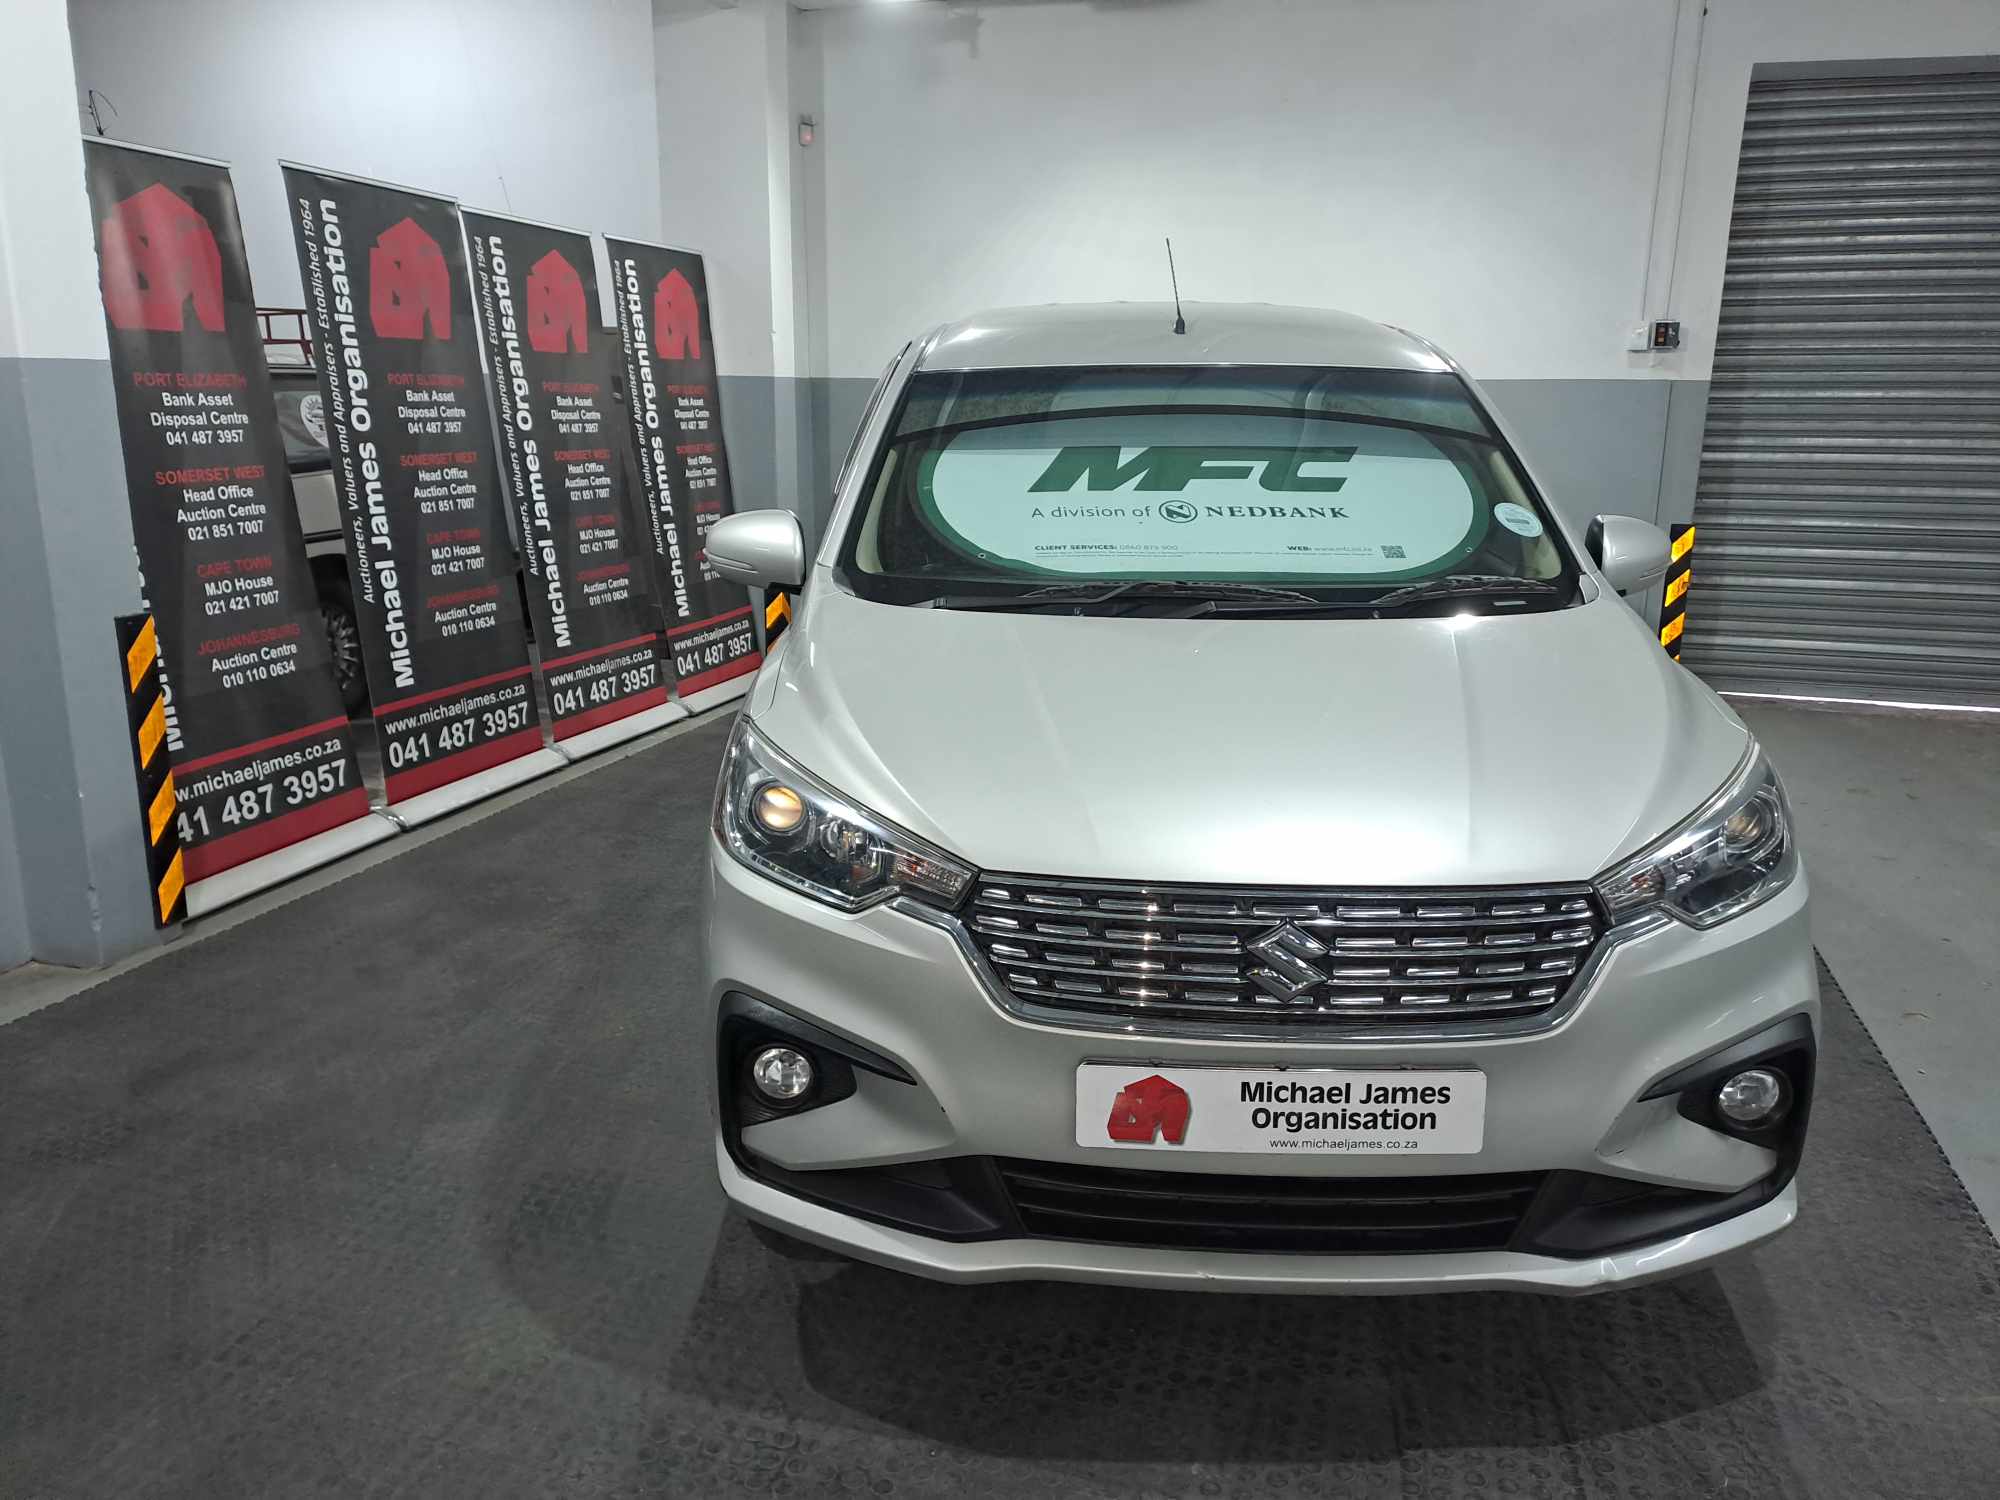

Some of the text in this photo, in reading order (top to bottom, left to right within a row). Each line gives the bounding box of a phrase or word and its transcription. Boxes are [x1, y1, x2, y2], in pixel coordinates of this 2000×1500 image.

[133, 371, 172, 387] PORT
[162, 391, 234, 407] Bank Asset
[299, 198, 375, 603] Auctioneers, Valuers and Appraisers Established 1964
[406, 390, 455, 402] Bank Asset
[473, 235, 539, 576] Auctioneers, Valuers and Appraisers Established 1964
[150, 410, 249, 428] Disposal Centre
[397, 405, 466, 420] Disposal Centre
[166, 429, 244, 446] 041 487 3957
[407, 422, 424, 434] 041
[425, 421, 441, 433] 487
[624, 258, 690, 617] Michael James Organisation
[320, 199, 415, 688] Michael James Organisation
[488, 236, 572, 648] Michael James Organisation
[155, 467, 230, 485] SOMERSET
[418, 467, 468, 481] Head Office
[1027, 445, 1358, 493] MFC
[183, 485, 254, 503] Head Office
[414, 483, 478, 498] Auction Centre
[177, 502, 266, 523] Auction Centre
[420, 498, 475, 513] 021 851 7007
[1032, 505, 1350, 518] A division of NEDBANK
[187, 519, 264, 541] 021 851 7007
[431, 544, 481, 560] MJO House
[431, 557, 485, 576] 021 421 7007
[204, 575, 274, 597] MJO House
[204, 590, 279, 616] 021 421 7007
[434, 602, 497, 622] Auction Centre
[441, 615, 496, 637] 010 110 0634
[674, 619, 750, 651] www.michaeljames.co.za
[211, 642, 298, 673] Auction Centre
[677, 633, 752, 676] 041 487 3957
[222, 659, 296, 689] 010 110 0634
[550, 649, 653, 687] www.michaeljames.co.za
[553, 664, 656, 716] 041 487 3957
[385, 684, 526, 735] www.michaeljames.co.za
[388, 701, 528, 769] 041 487 3957
[174, 737, 342, 802] w.michaeljames.co.za
[177, 758, 347, 842] 41 487 3957
[1240, 1081, 1451, 1105] Michael James
[1251, 1107, 1437, 1132] Organisation
[1269, 1138, 1419, 1151] www.michaeljames.co.za
